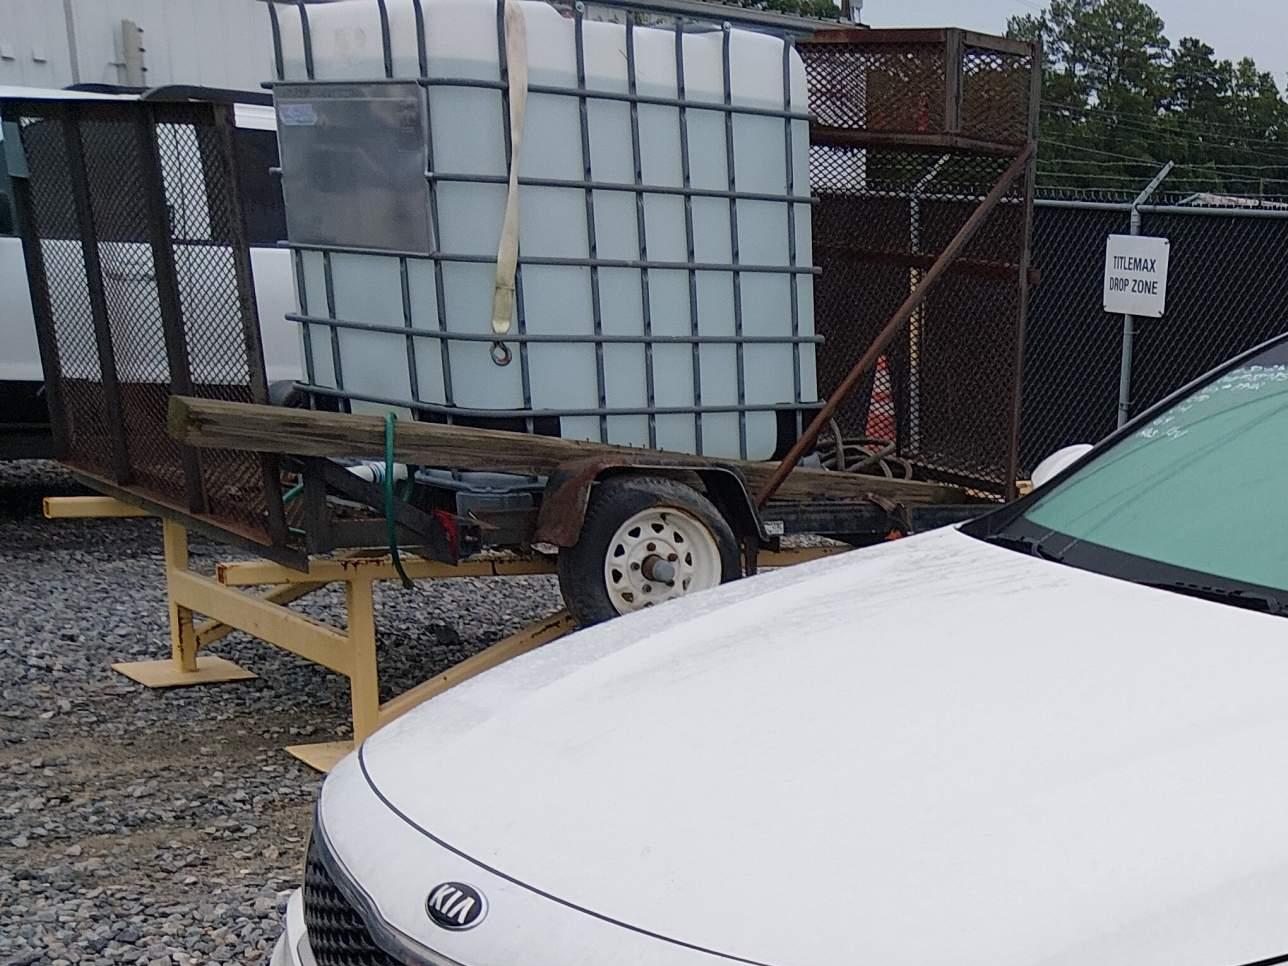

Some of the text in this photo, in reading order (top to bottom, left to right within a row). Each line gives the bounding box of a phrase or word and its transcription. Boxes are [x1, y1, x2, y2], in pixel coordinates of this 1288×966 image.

[1113, 256, 1156, 272] TITLEMAX
[1109, 277, 1158, 295] DROP ZONE
[429, 884, 475, 924] KIA
